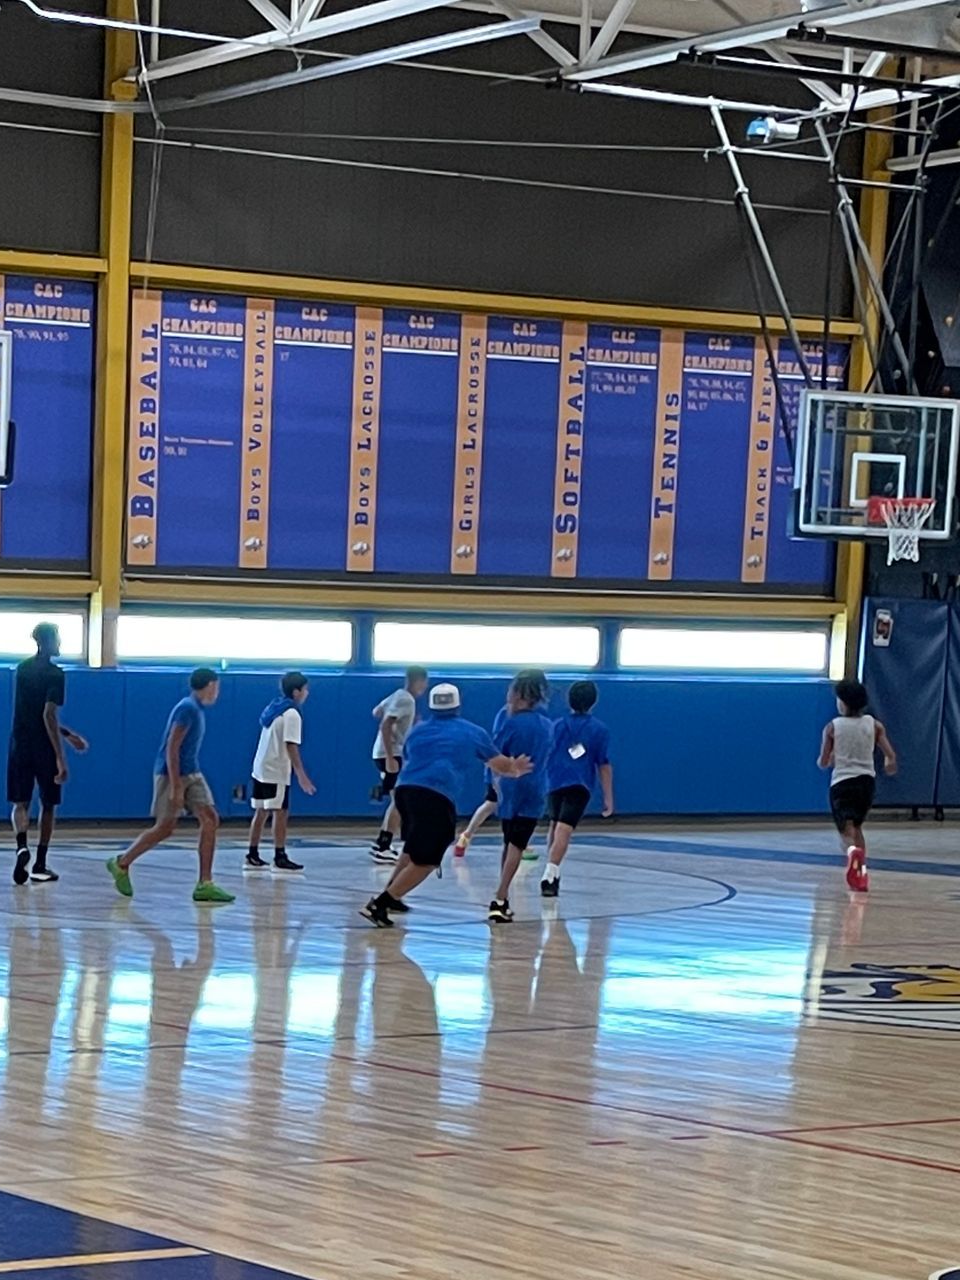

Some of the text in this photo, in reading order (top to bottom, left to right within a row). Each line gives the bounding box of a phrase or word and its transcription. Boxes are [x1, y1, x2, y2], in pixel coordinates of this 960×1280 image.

[34, 282, 63, 298] CAC
[5, 302, 90, 323] CHAMPIONS
[190, 299, 217, 314] CAC
[301, 307, 328, 321] CAC
[162, 318, 244, 337] CHAMPIONS
[408, 314, 434, 329] CAC
[512, 322, 537, 337] CAC
[275, 326, 353, 344] CHAMPIONS
[382, 333, 459, 351] CHAMPIONS
[611, 330, 636, 344] CAC
[487, 341, 560, 358] CHAMPIONS
[707, 337, 731, 351] CAC
[588, 348, 657, 364] CHAMPIONS
[684, 356, 752, 371] CHAMPIONS
[130, 323, 159, 518] BASEBALL
[246, 311, 266, 521] BOYS VOLLEYBALL
[354, 330, 376, 526] BOYS LACROSSE
[458, 336, 481, 531] GIRLS LACROSSE
[555, 346, 585, 534] SOFTBALL
[756, 439, 769, 451] &
[653, 393, 680, 519] TENNIS
[750, 467, 768, 540] TRACK
